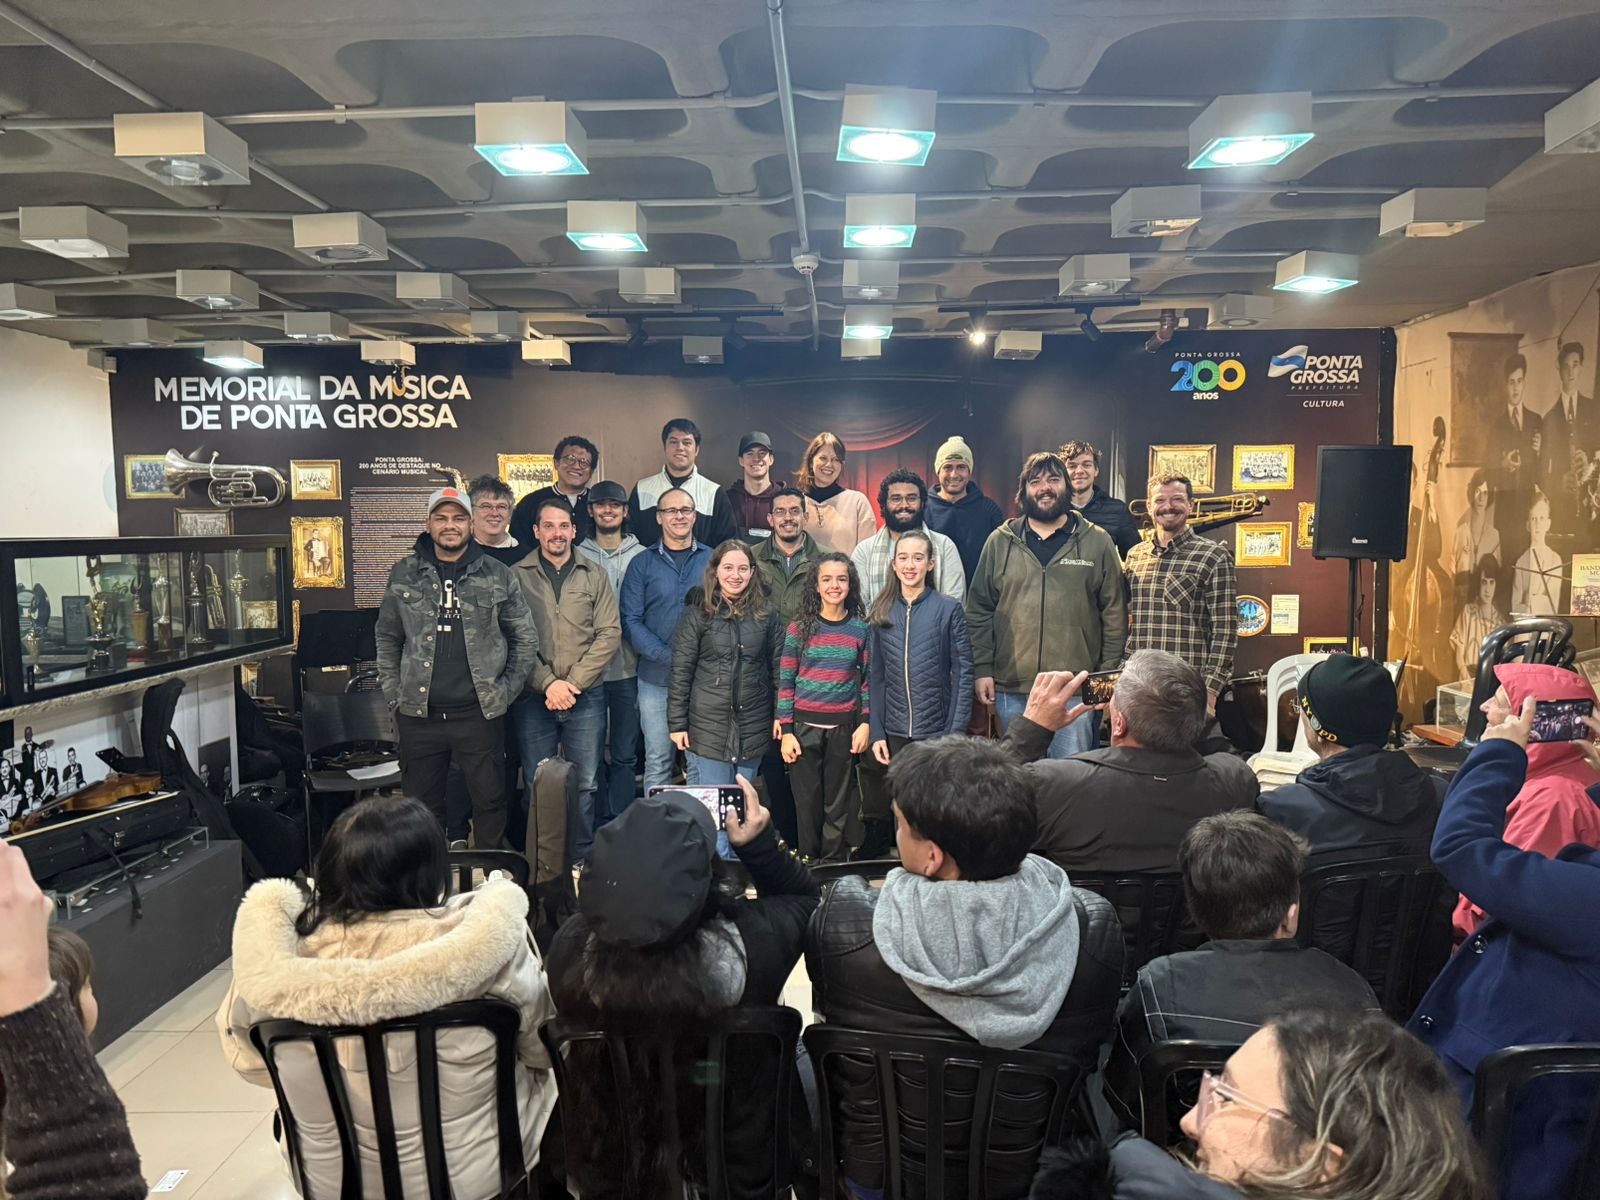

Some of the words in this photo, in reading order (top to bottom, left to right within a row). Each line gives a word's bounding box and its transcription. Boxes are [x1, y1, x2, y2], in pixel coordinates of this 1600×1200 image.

[1304, 355, 1363, 369] PONTA
[1170, 360, 1246, 391] 200
[1290, 369, 1360, 384] GROSSA
[154, 375, 311, 402] MEMORIAL
[319, 374, 362, 401] DA
[1192, 392, 1219, 401] anos
[1302, 400, 1345, 408] CULTURA
[180, 404, 222, 431] DE
[230, 403, 327, 430] PONTA
[333, 403, 458, 429] GROSSA
